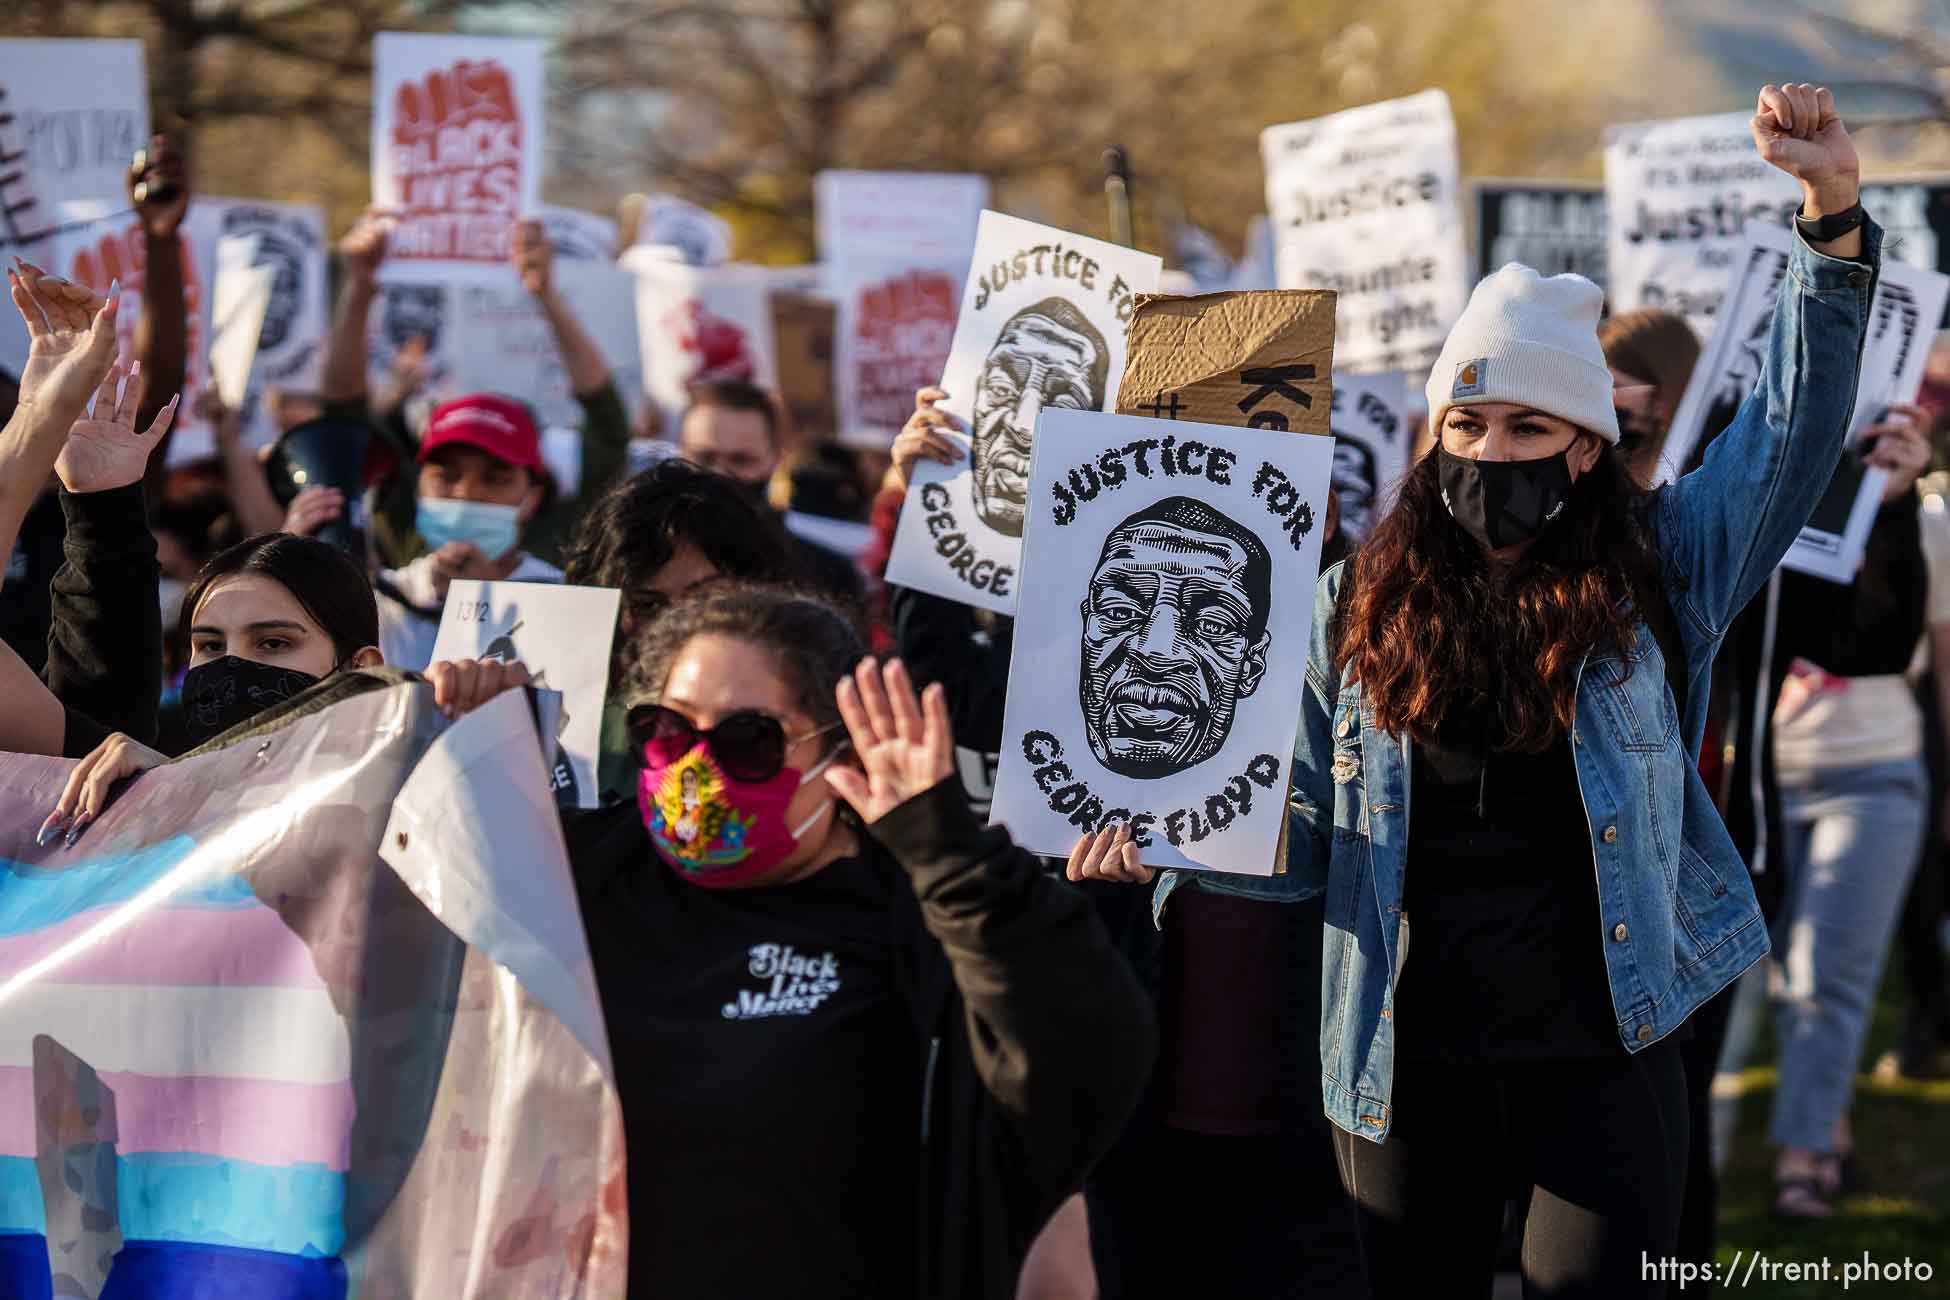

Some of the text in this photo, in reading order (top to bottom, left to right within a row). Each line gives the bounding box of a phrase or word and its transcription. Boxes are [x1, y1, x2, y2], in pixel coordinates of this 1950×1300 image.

[974, 243, 1100, 311] JUSTICE
[1052, 434, 1315, 551] JUSTICE FOR
[920, 482, 1016, 597] GEORGE
[1163, 754, 1280, 848] FLOYD
[748, 942, 839, 979] Black
[770, 974, 842, 999] Lives
[721, 990, 829, 1019] Matter
